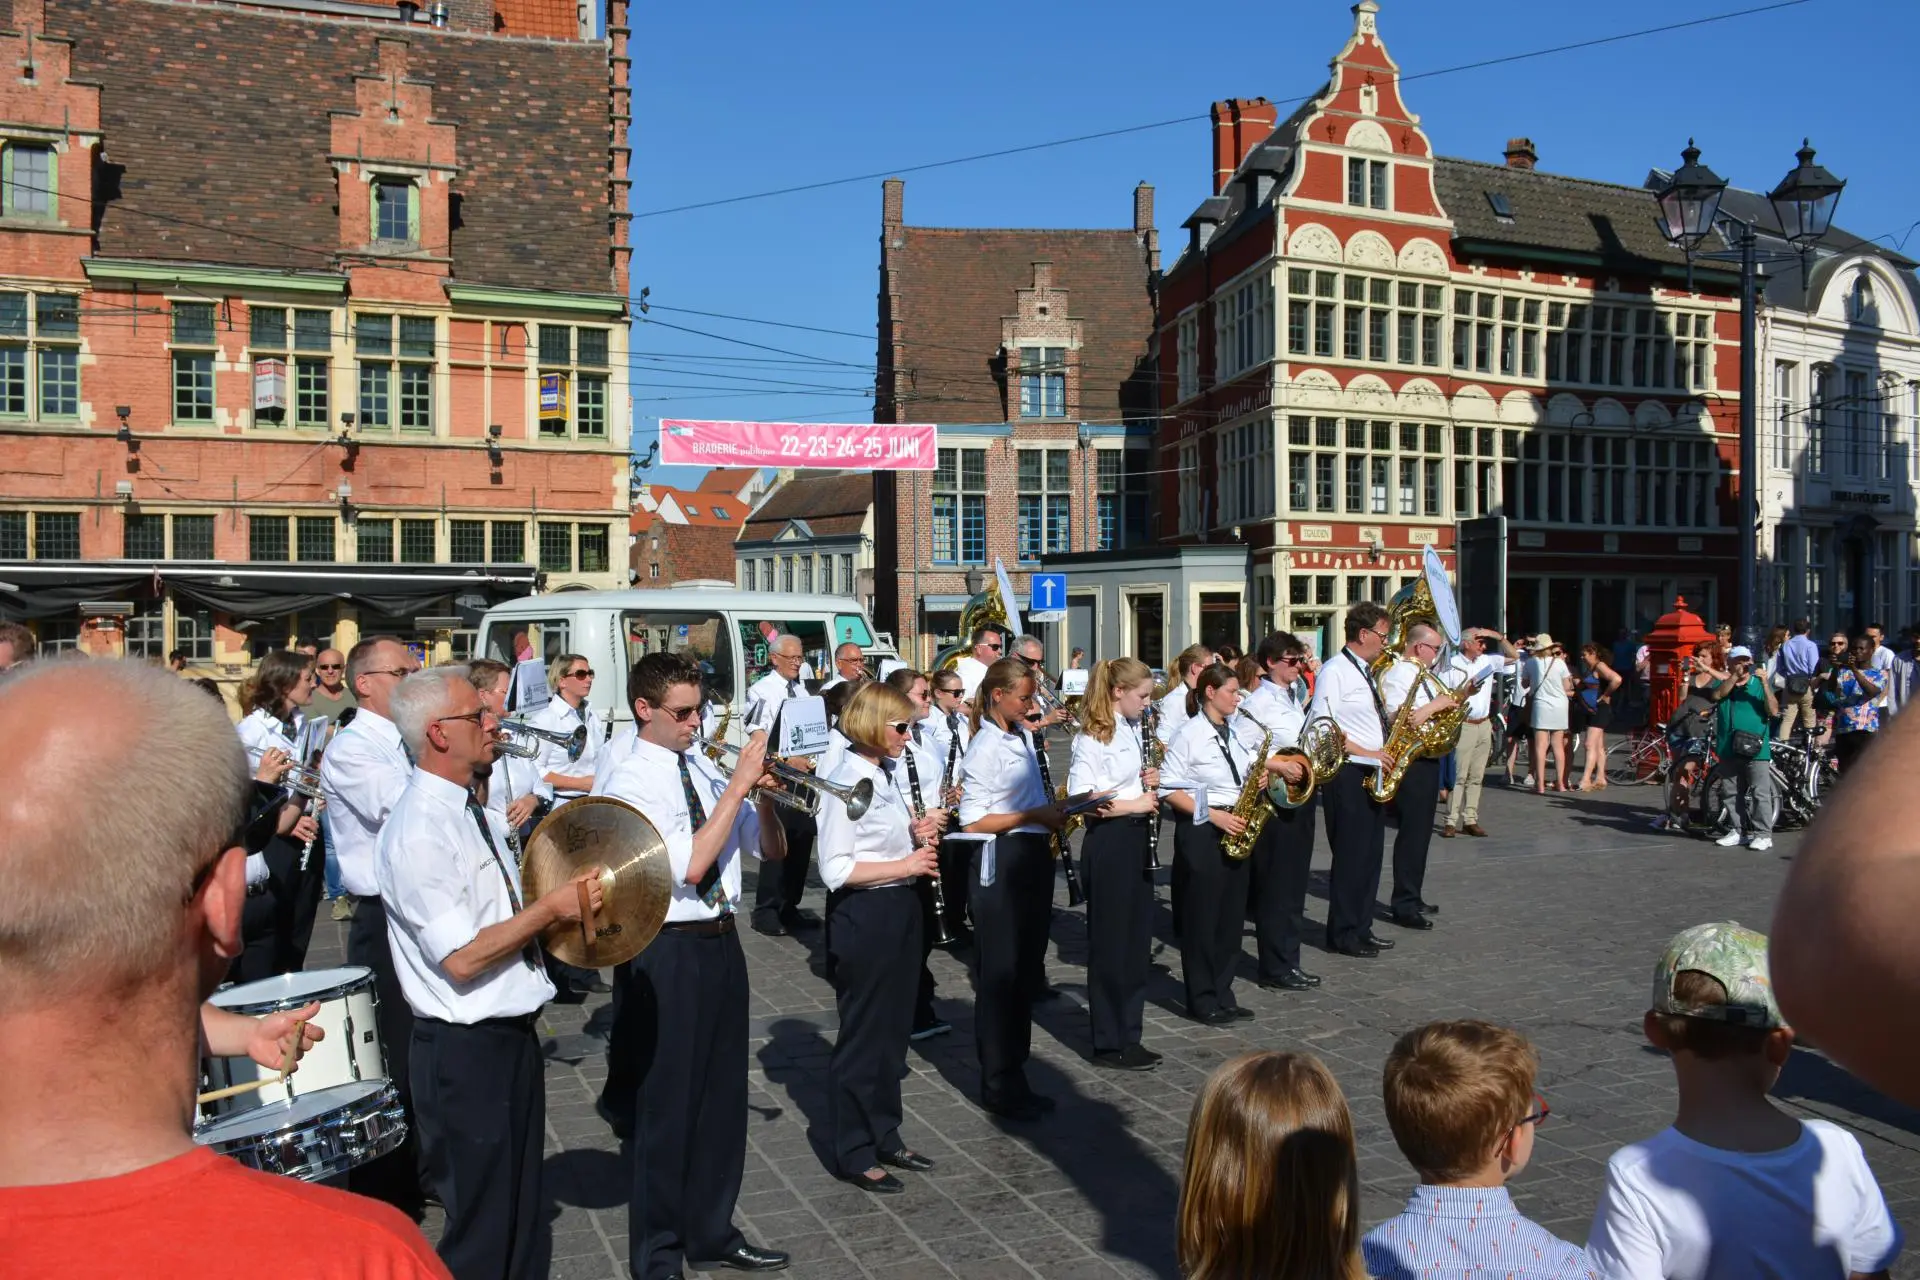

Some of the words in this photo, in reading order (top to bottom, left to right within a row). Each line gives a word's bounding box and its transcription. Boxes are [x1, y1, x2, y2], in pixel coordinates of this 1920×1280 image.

[692, 442, 738, 455] BRADERIE
[780, 434, 882, 458] 22-23-24-25
[885, 435, 920, 458] JUNI
